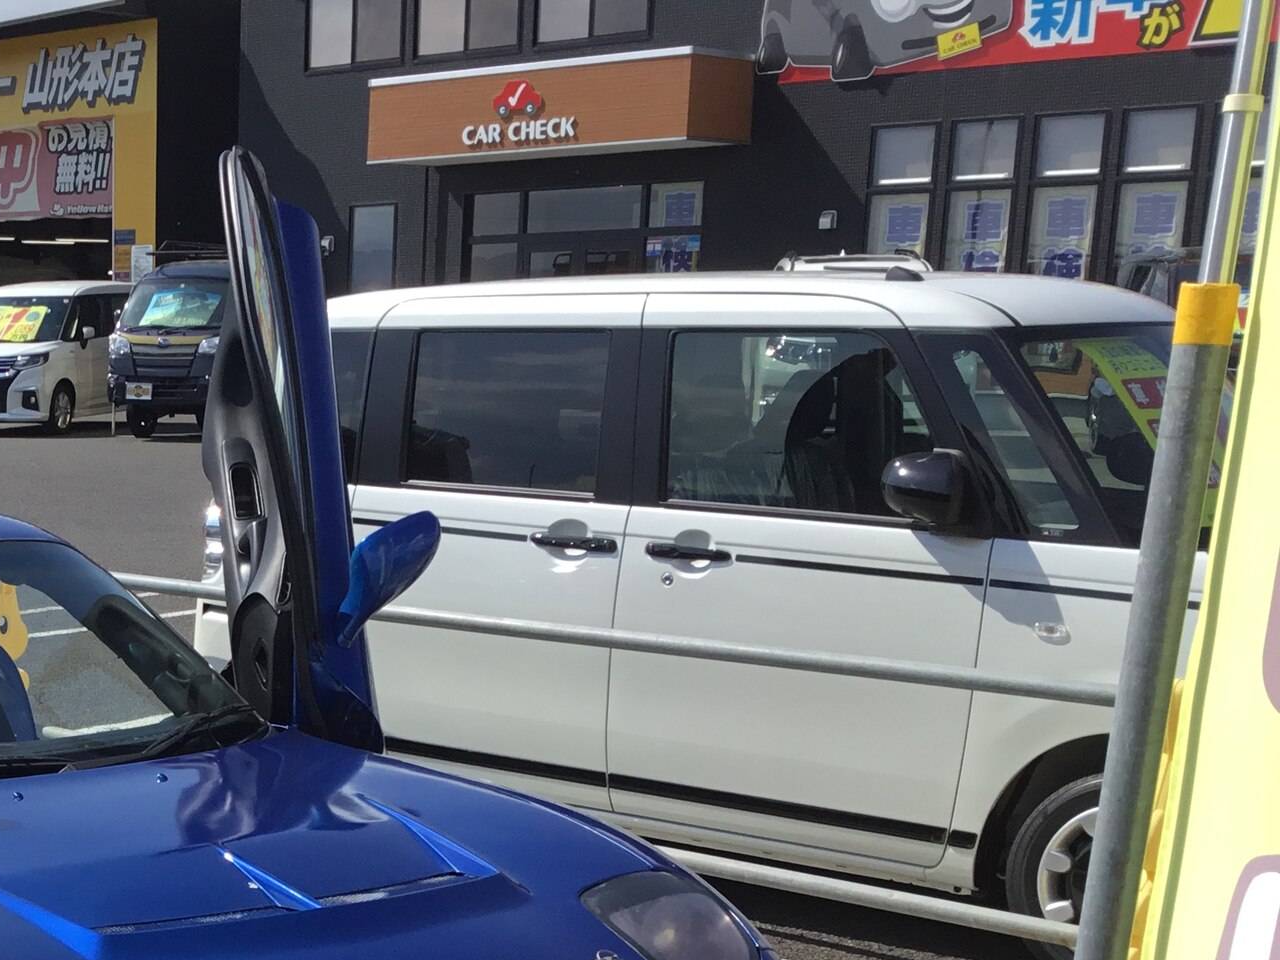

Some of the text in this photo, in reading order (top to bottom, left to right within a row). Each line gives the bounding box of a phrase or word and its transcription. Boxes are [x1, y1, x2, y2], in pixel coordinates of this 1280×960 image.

[23, 34, 146, 110] 山形本店
[462, 116, 575, 145] CAR CHECK
[55, 151, 111, 193] 無料!!
